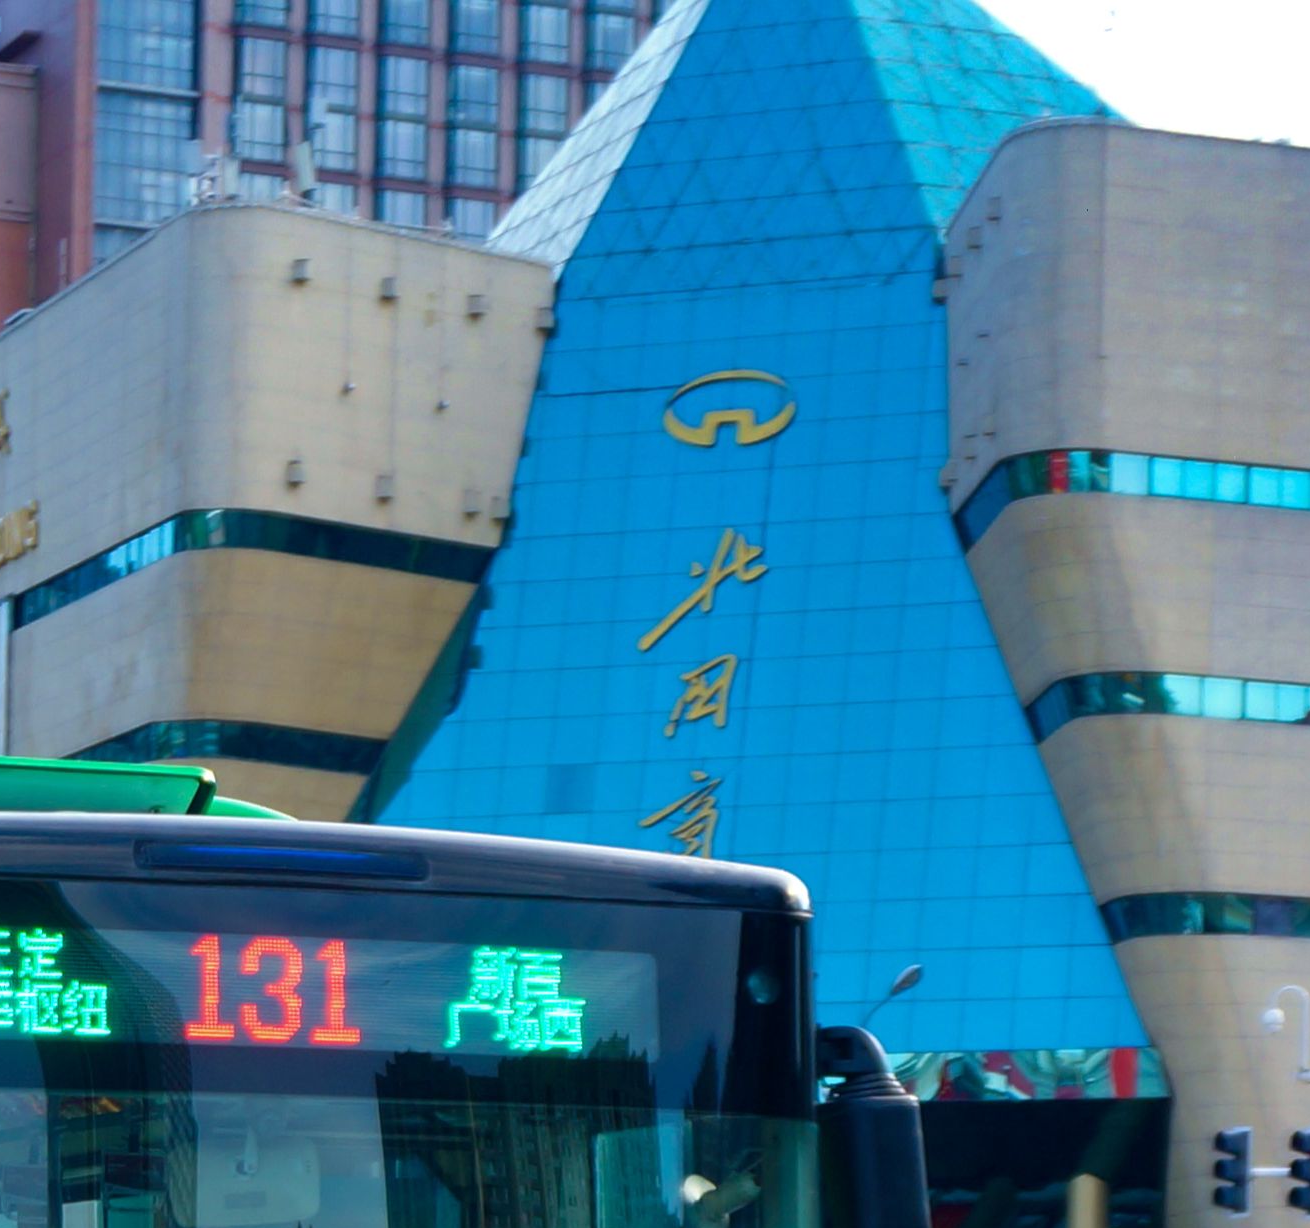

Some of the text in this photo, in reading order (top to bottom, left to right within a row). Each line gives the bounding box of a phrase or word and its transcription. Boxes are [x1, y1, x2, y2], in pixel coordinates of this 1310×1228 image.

[184, 931, 363, 1046] 131
[469, 945, 564, 1003] 新百
[443, 997, 587, 1052] 广场西
